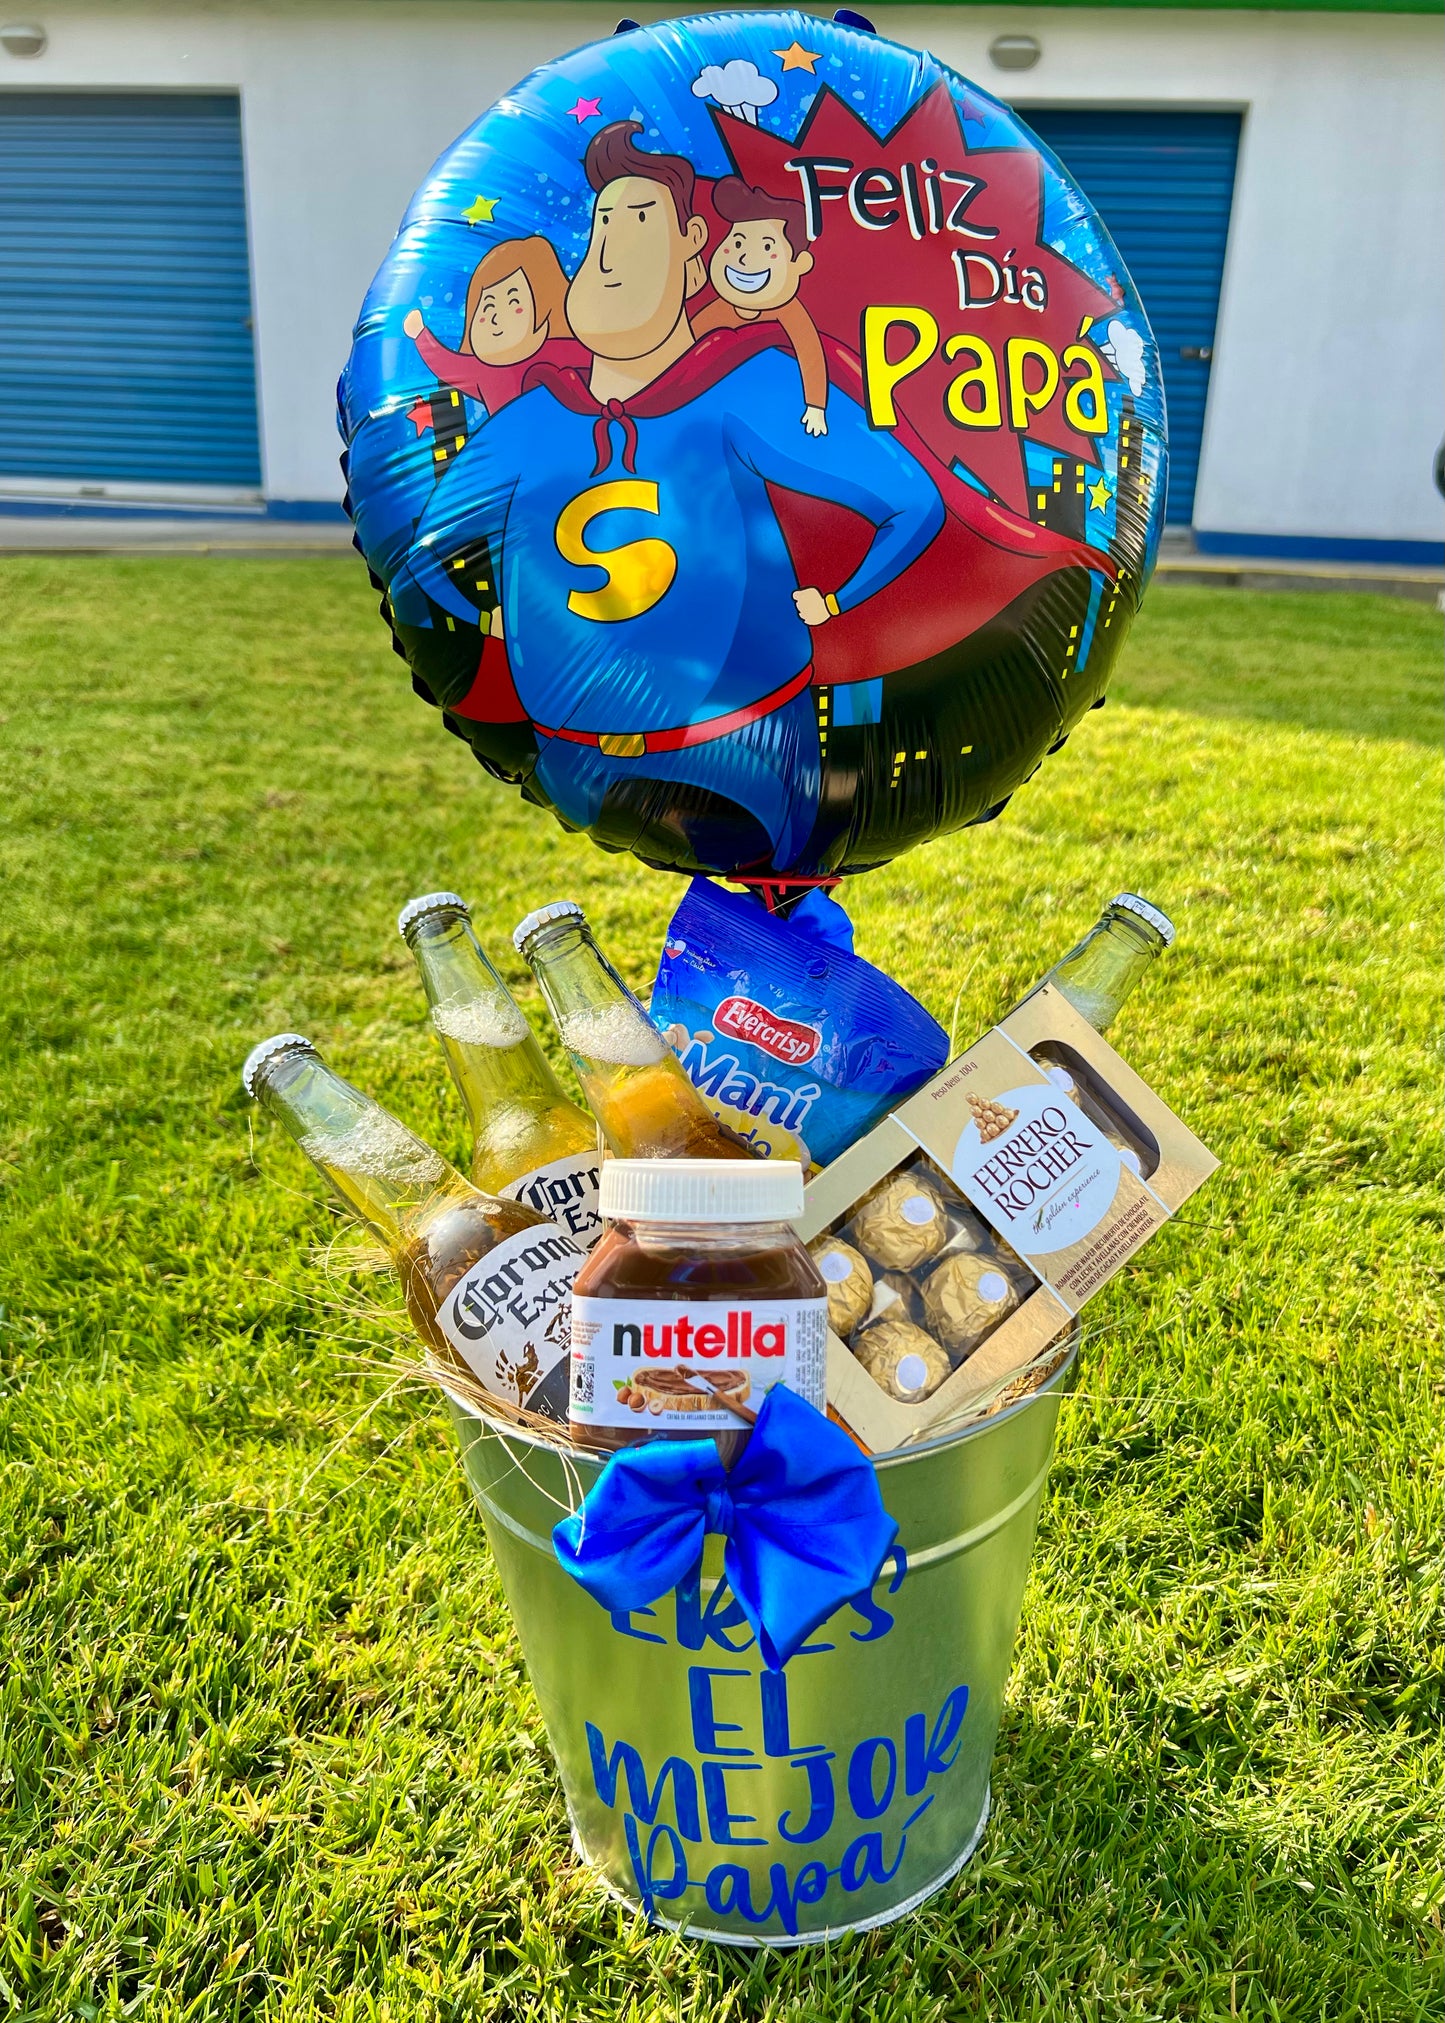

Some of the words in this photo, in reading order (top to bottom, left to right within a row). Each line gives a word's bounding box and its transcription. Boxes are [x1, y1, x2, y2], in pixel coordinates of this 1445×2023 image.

[784, 158, 999, 240] Feliz
[952, 248, 1049, 313] Día
[860, 305, 1109, 434] Papá
[554, 479, 678, 622] S
[722, 1001, 811, 1060] Evercrisp
[681, 1041, 820, 1131] Maní
[931, 1083, 948, 1100] Peso
[944, 1075, 963, 1090] Neto:
[959, 1064, 973, 1076] 100
[971, 1061, 978, 1069] g
[972, 1107, 1067, 1197] FERRERO
[994, 1131, 1093, 1221] ROCHER
[562, 1203, 603, 1236] Ex
[1033, 1219, 1045, 1235] the
[1045, 1202, 1067, 1230] golden
[1067, 1168, 1101, 1203] experience
[1054, 1267, 1076, 1290] BOMBÓN
[1073, 1261, 1082, 1271] DE
[1078, 1247, 1096, 1265] WAFER
[1092, 1223, 1120, 1251] RECUBIERTO
[1116, 1217, 1126, 1227] DE
[1122, 1194, 1149, 1221] CHOCOLATE
[453, 1236, 586, 1340] Corona
[1067, 1276, 1081, 1290] CON
[1077, 1262, 1095, 1280] LECHE
[1093, 1236, 1121, 1264] AVELLANAS
[1116, 1227, 1130, 1241] CON
[1125, 1208, 1148, 1232] CREMOSO
[1074, 1275, 1097, 1297] RELLENO
[1093, 1269, 1103, 1279] DE
[1099, 1255, 1116, 1273] CACAO
[1116, 1231, 1140, 1255] AVELLANA
[1136, 1216, 1155, 1235] ENTERA
[613, 1311, 785, 1358] nutella
[688, 1666, 826, 1757] EL
[585, 1685, 969, 1845] MEJOR
